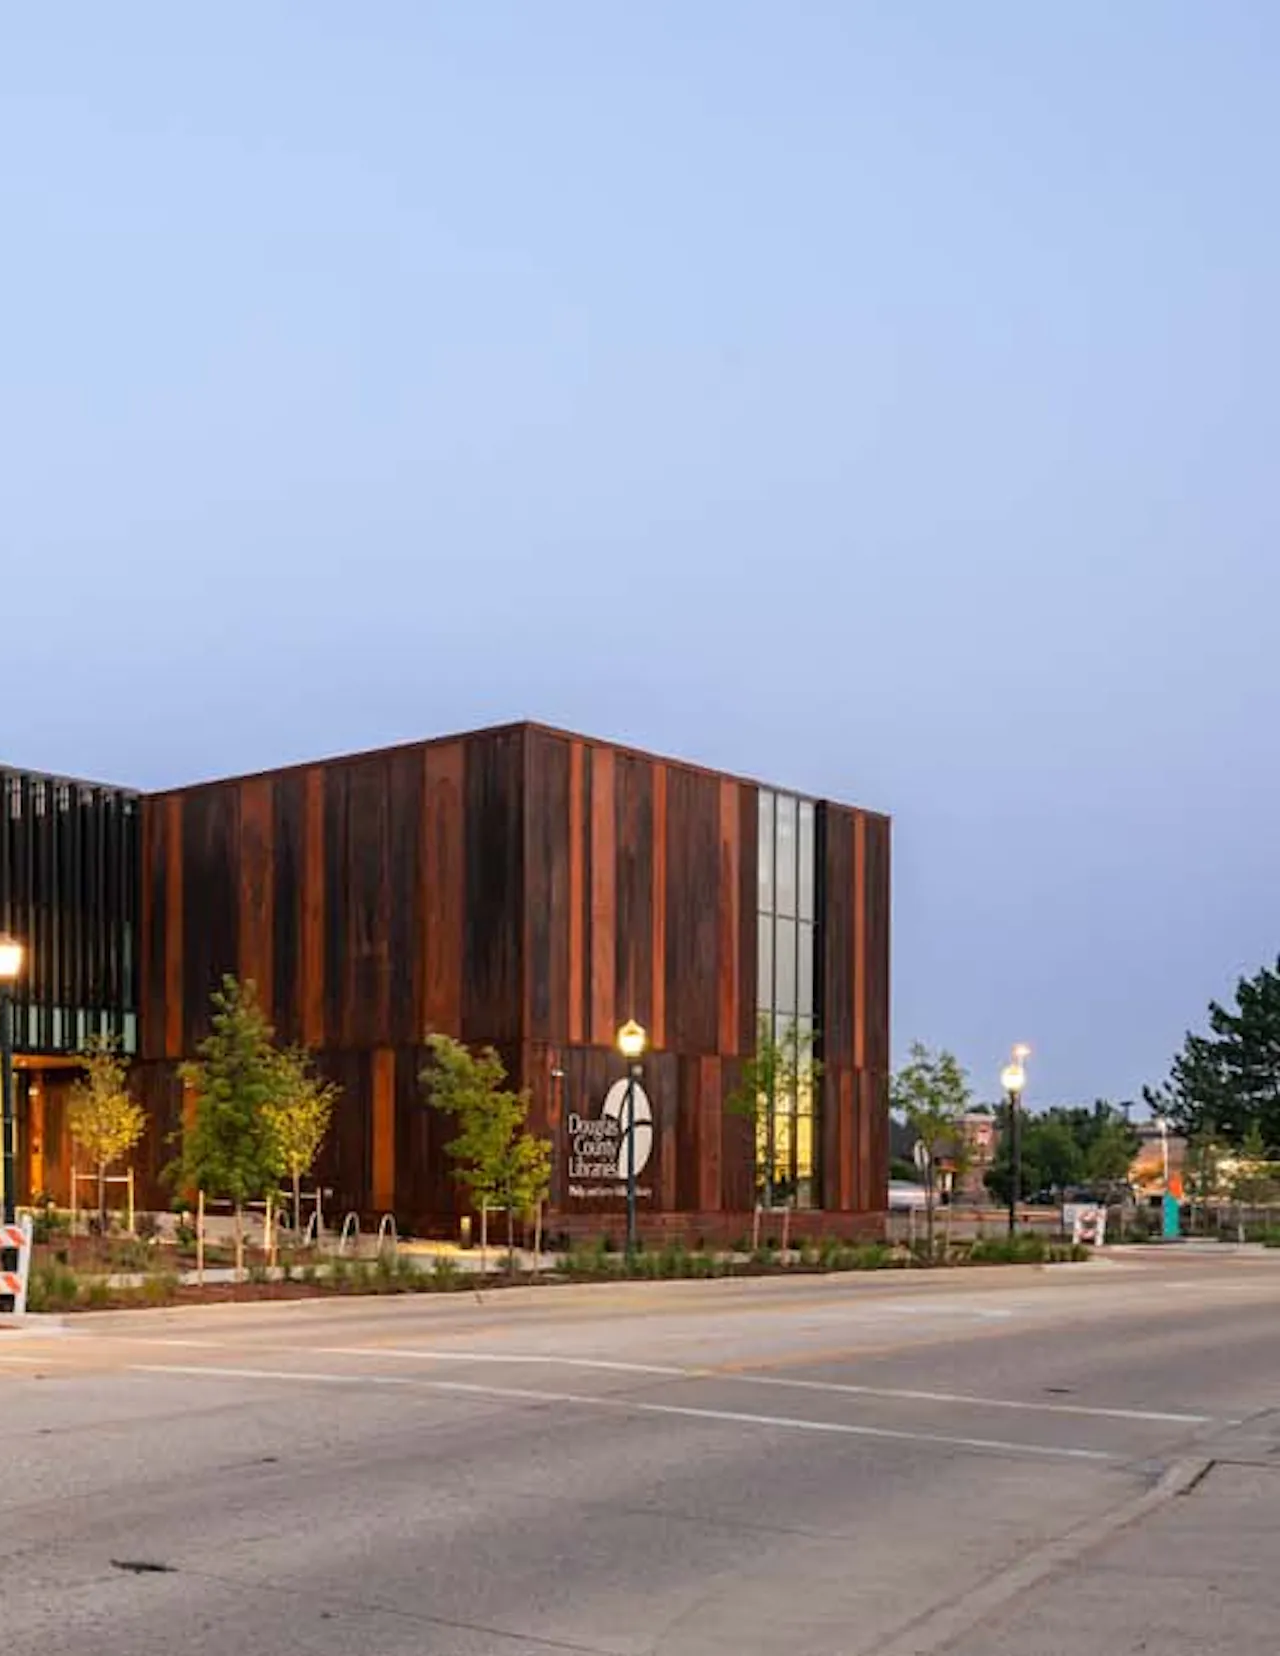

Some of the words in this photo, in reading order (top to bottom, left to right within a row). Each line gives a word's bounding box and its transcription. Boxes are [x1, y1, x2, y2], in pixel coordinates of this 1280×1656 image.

[568, 1113, 618, 1139] Douglas
[573, 1135, 618, 1161] County
[568, 1155, 618, 1178] Libraries
